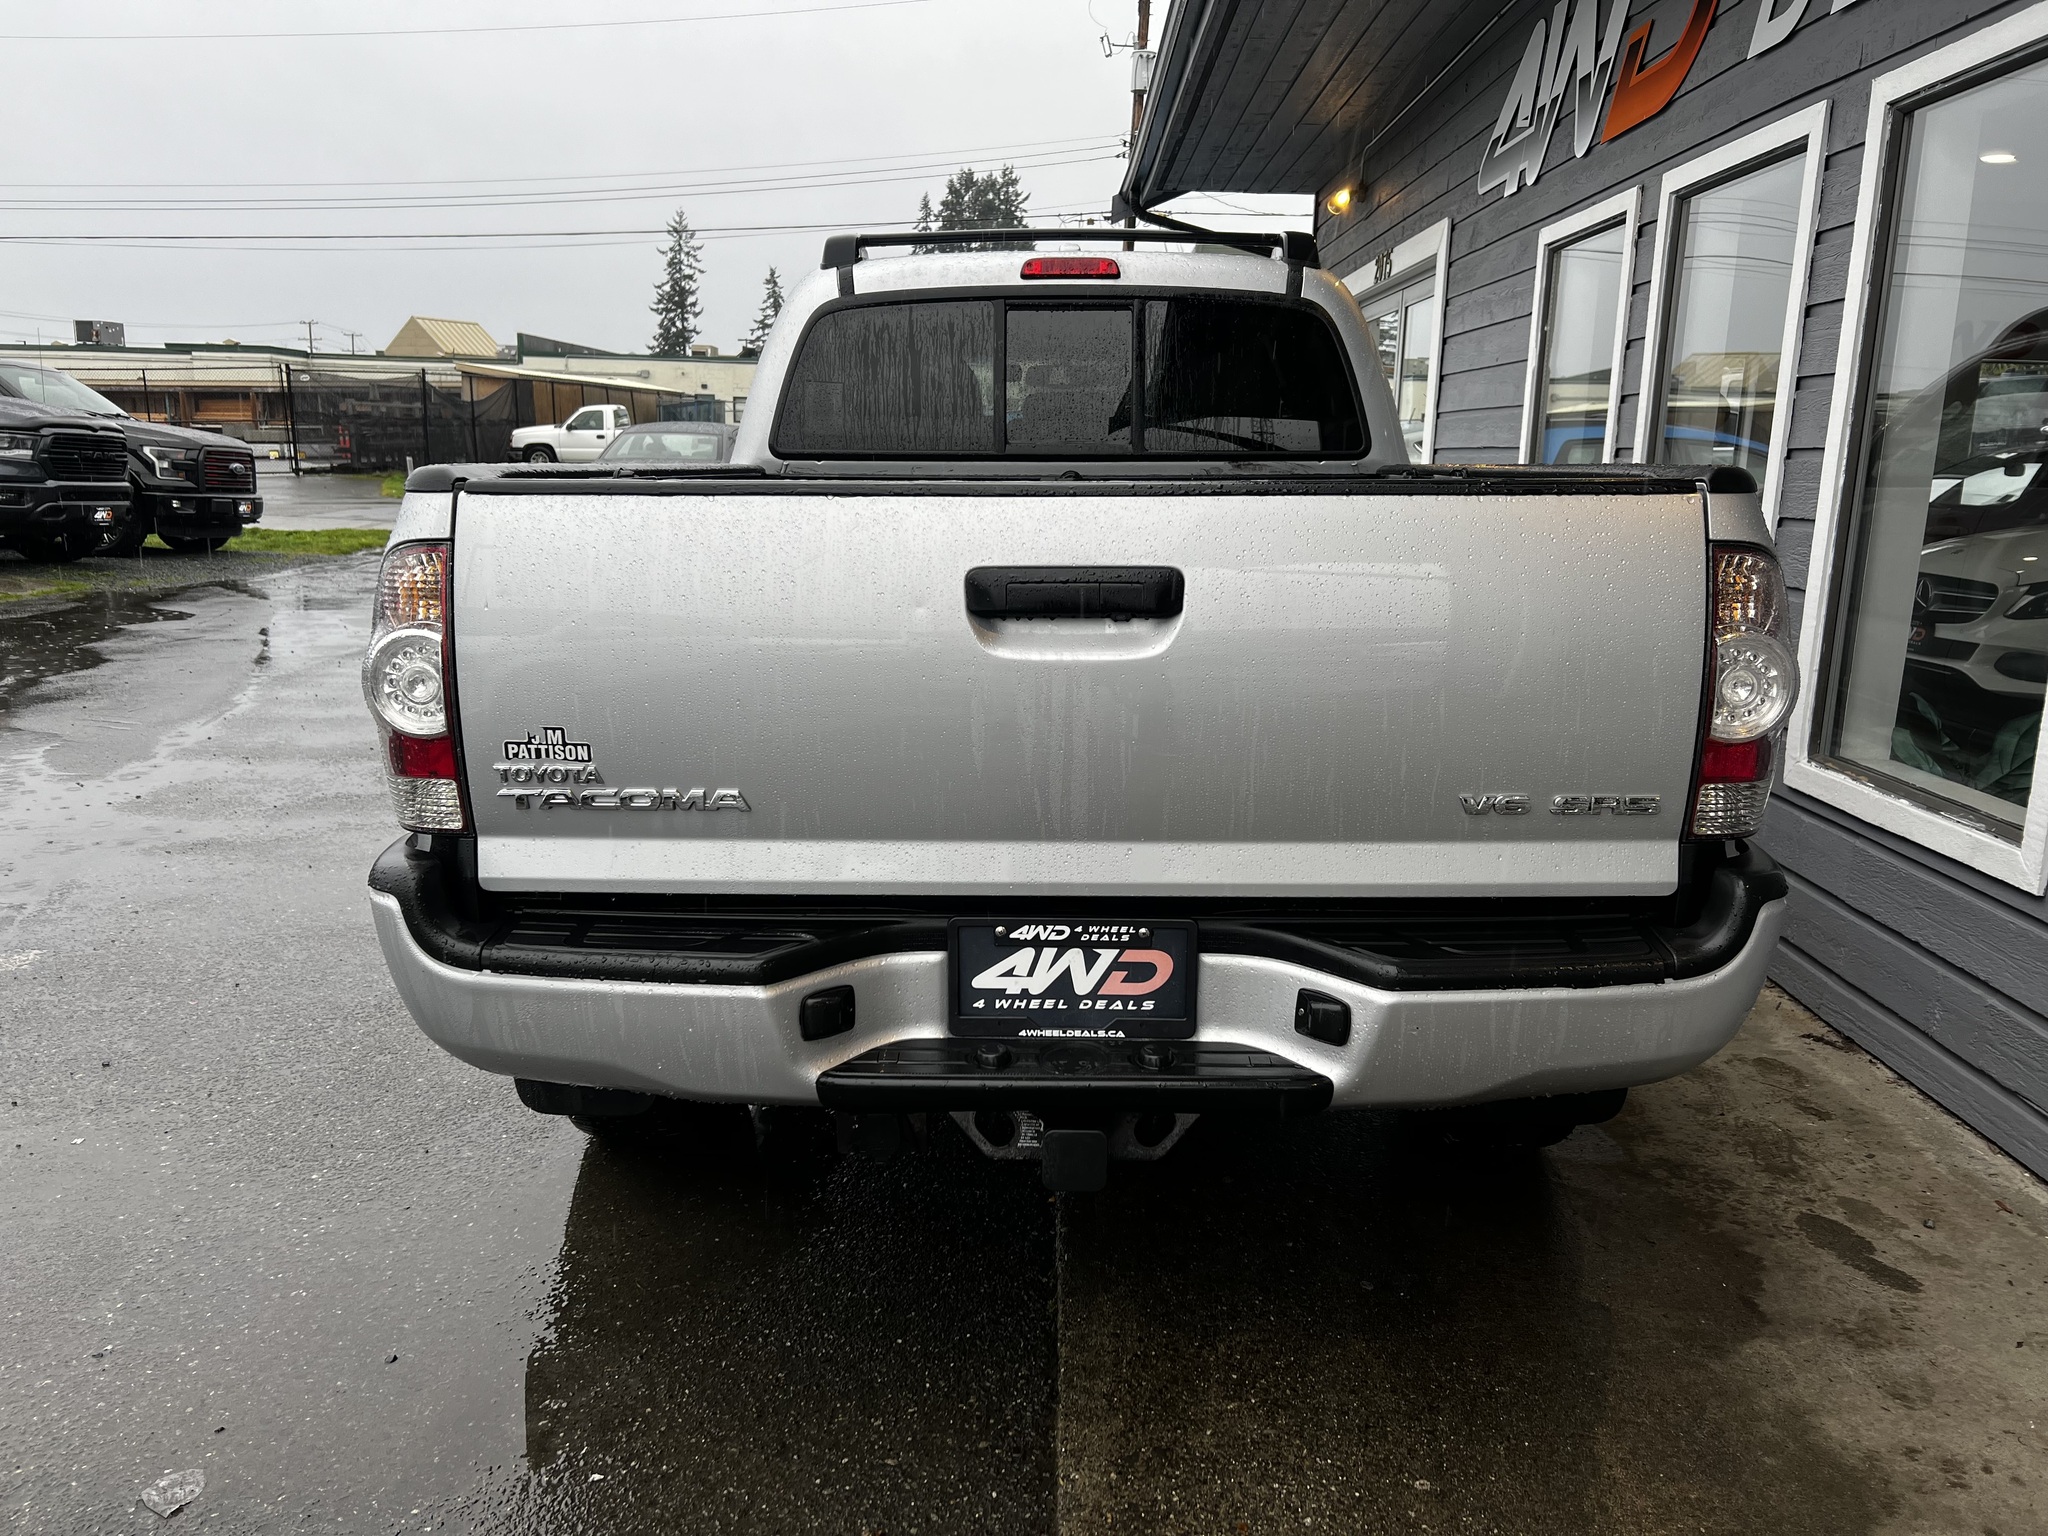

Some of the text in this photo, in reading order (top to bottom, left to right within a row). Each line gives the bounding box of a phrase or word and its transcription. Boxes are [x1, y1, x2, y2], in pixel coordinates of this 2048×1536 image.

[1478, 0, 1718, 198] 4WD
[531, 729, 563, 745] JM
[507, 744, 590, 761] PATTISON
[492, 763, 605, 785] TOYOTA
[496, 787, 752, 812] TACOMA
[1458, 793, 1662, 816] V6 SR5
[1008, 924, 1137, 941] 4WD 4 WHEEL
[1080, 934, 1130, 942] DEALS
[971, 947, 1174, 996] 4WD
[972, 998, 1156, 1011] 4 WHEEL DEALS
[1018, 1028, 1126, 1038] 4WHEELDEALS.CA
